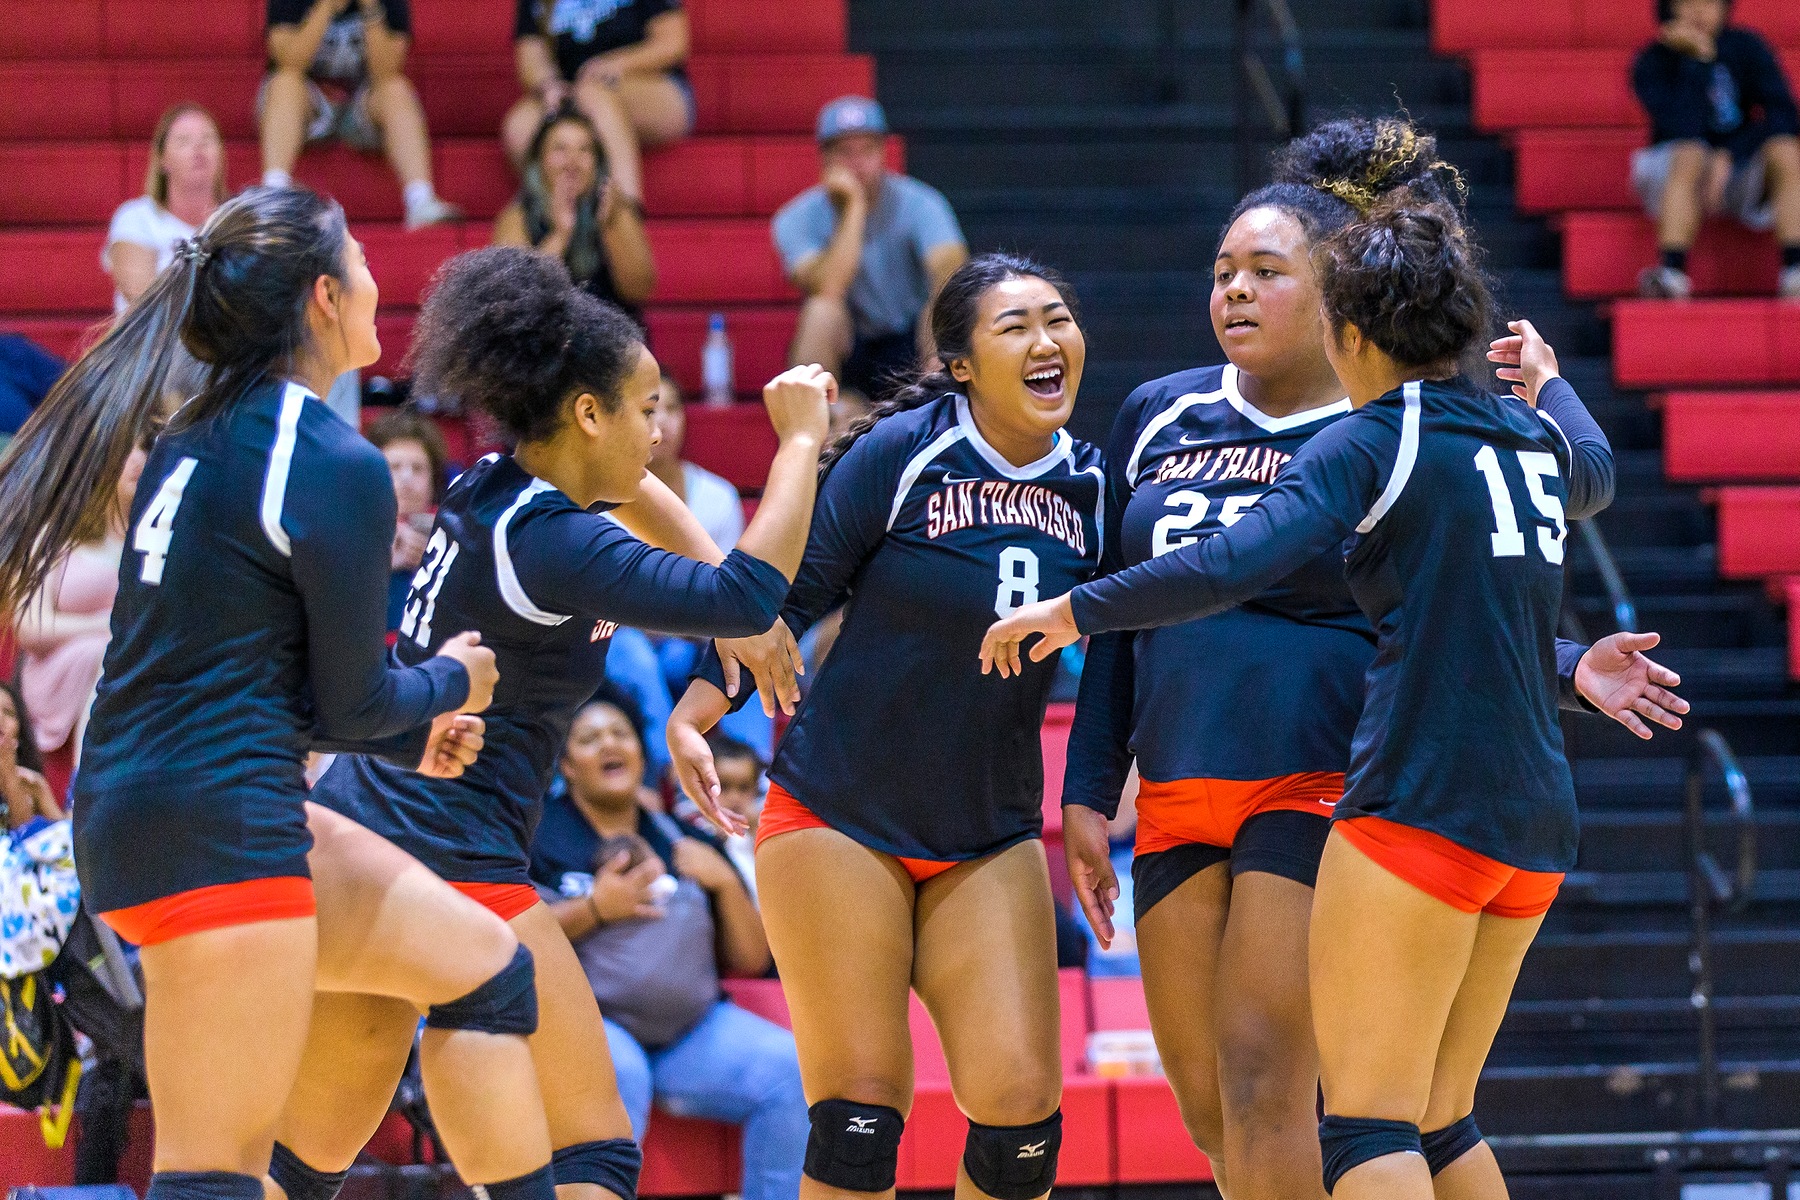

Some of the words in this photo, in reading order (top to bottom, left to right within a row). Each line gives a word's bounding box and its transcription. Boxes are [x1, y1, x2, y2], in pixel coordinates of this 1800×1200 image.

[134, 456, 199, 585] 4
[927, 481, 976, 540] SAN
[979, 480, 1087, 558] FRANCISCO
[1473, 444, 1568, 566] 15
[400, 526, 460, 649] 21
[994, 546, 1040, 620] 8
